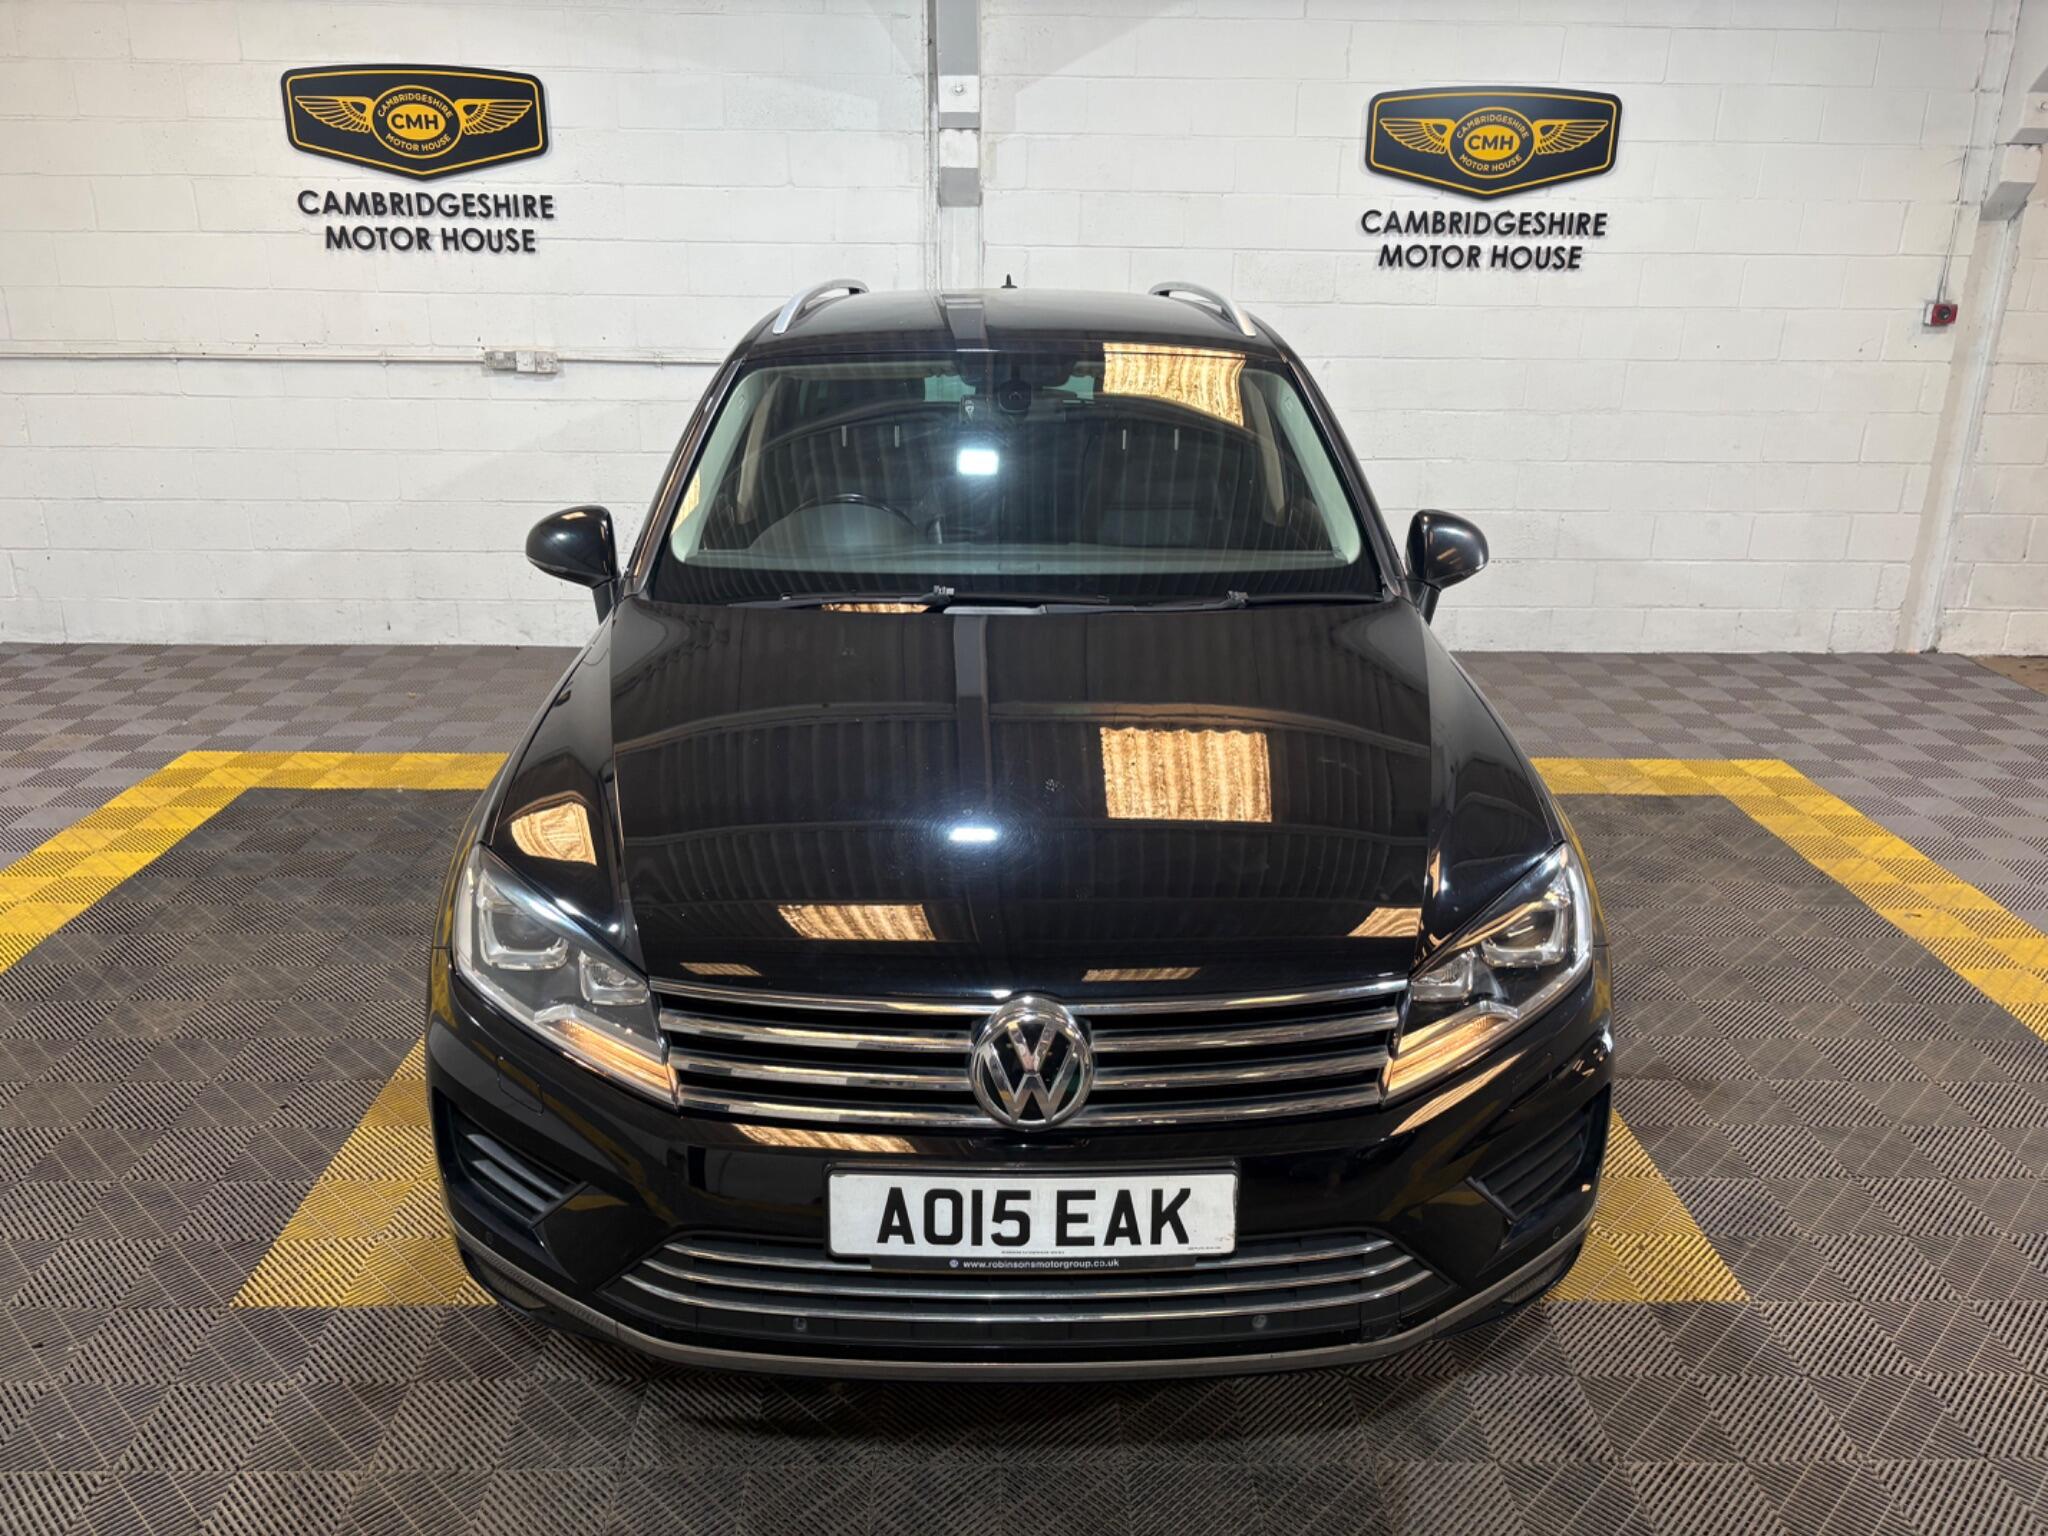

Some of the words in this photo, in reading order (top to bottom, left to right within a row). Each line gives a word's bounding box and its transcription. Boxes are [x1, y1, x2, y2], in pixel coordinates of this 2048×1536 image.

[377, 92, 454, 119] CAMBRIDGESHIRE
[391, 113, 439, 130] CMH
[1456, 114, 1530, 139] CAMBRIDGESHIRE
[385, 133, 420, 152] MOTOR
[421, 133, 452, 152] HOUSE
[1468, 134, 1514, 151] CMH
[1459, 153, 1490, 172] MOTOR
[1491, 153, 1523, 172] HOUSE
[297, 190, 555, 219] CAMBRIDGESHIRE
[1360, 209, 1609, 237] CAMBRIDGESHIRE
[325, 225, 432, 251] MOTOR
[441, 227, 537, 253] HOUSE
[1378, 244, 1482, 268] MOTOR
[1490, 245, 1584, 270] HOUSE
[876, 1186, 1032, 1247] AO15
[1054, 1187, 1192, 1247] EAK
[963, 1258, 1120, 1270] www.robinsonsmotorgroup.co.uk
